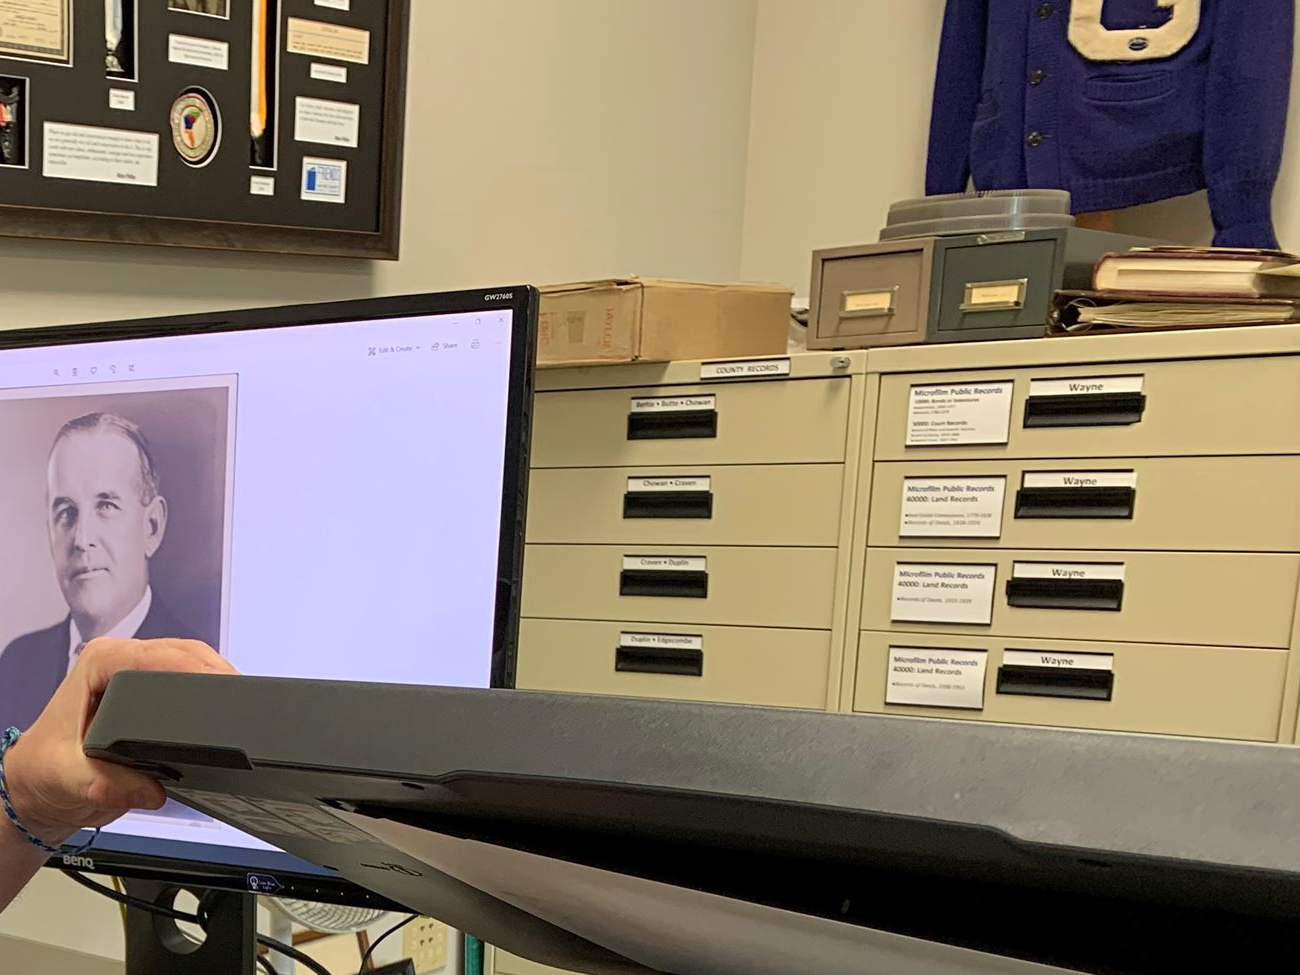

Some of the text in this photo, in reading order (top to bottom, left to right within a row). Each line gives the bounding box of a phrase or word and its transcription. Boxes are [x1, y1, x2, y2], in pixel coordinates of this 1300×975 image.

[1068, 0, 1200, 61] G
[715, 364, 780, 375] COUNTY RECORDS
[914, 386, 1003, 397] Microfilm Public Records
[1068, 382, 1104, 393] Wayne
[1063, 476, 1098, 487] Wayne
[907, 485, 941, 493] Microfilm
[668, 559, 689, 567] Duplin
[1051, 568, 1086, 579] Wayne
[657, 636, 693, 644] Edgecombe
[893, 656, 927, 664] Microfilm
[928, 657, 949, 665] Public
[1040, 656, 1075, 667] Wayne
[62, 855, 96, 870] BenQ
